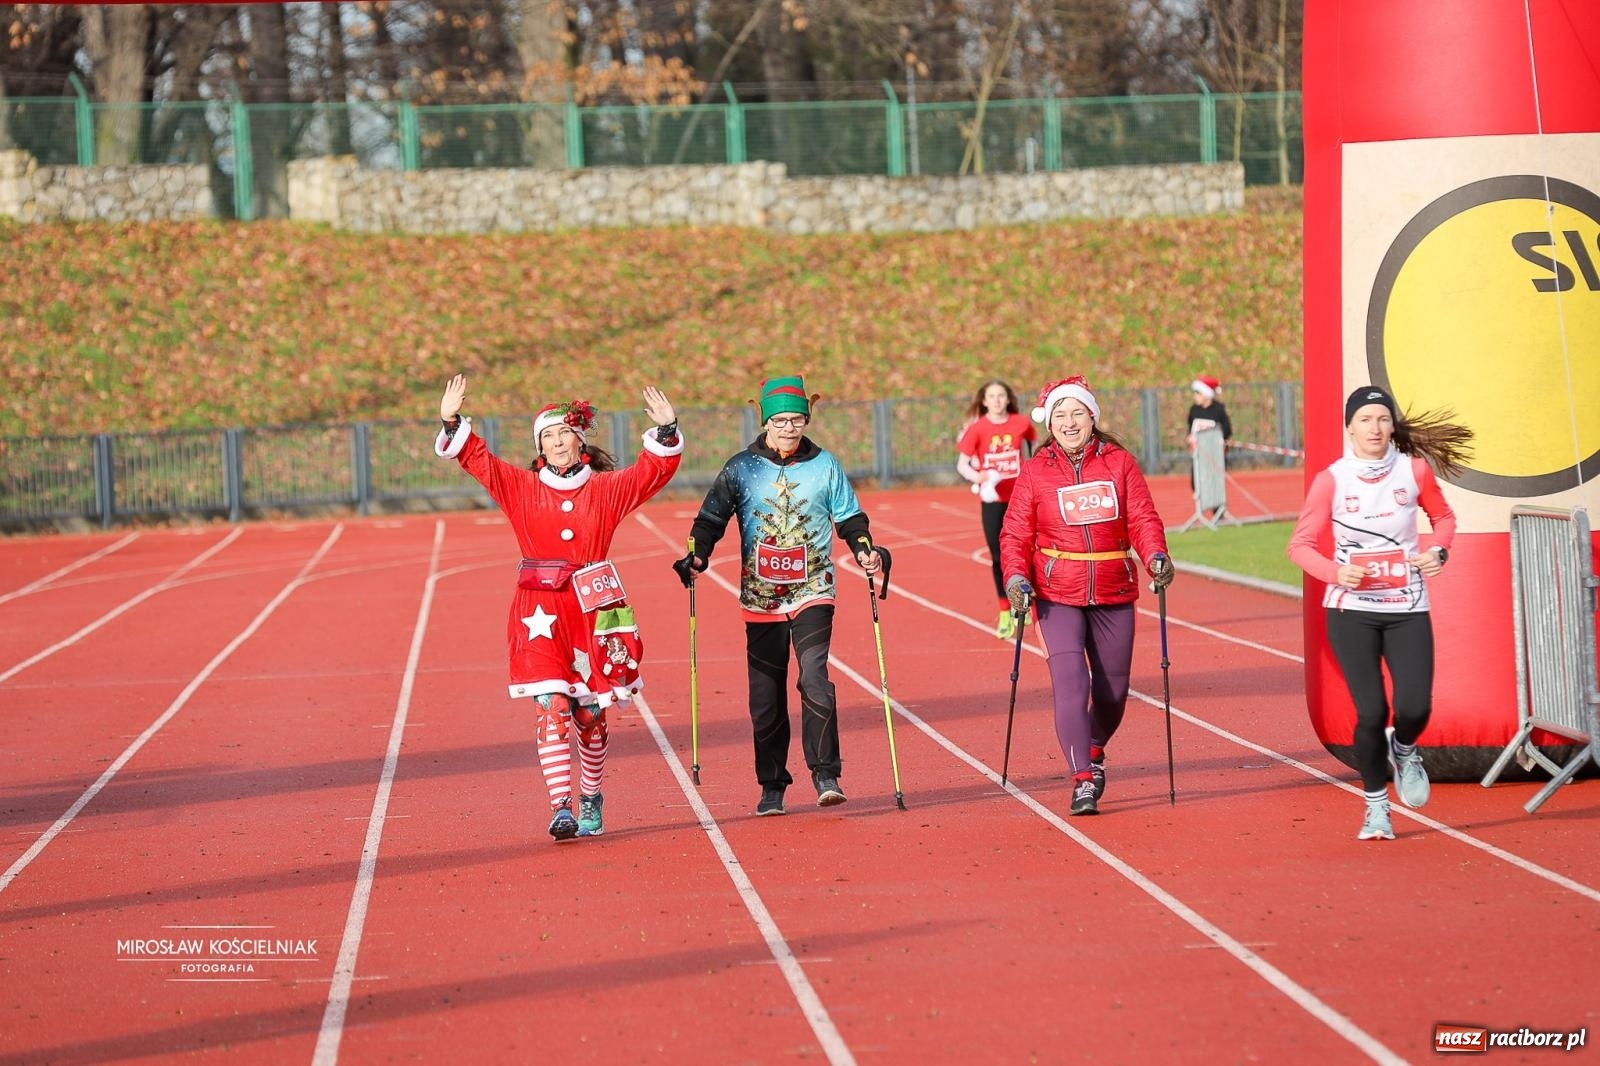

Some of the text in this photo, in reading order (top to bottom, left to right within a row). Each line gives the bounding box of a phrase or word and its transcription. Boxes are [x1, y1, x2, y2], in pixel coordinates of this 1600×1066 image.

[1511, 231, 1600, 293] SI
[1078, 494, 1101, 511] 29
[770, 556, 792, 571] 68
[1367, 561, 1390, 578] 31
[592, 574, 611, 593] 69
